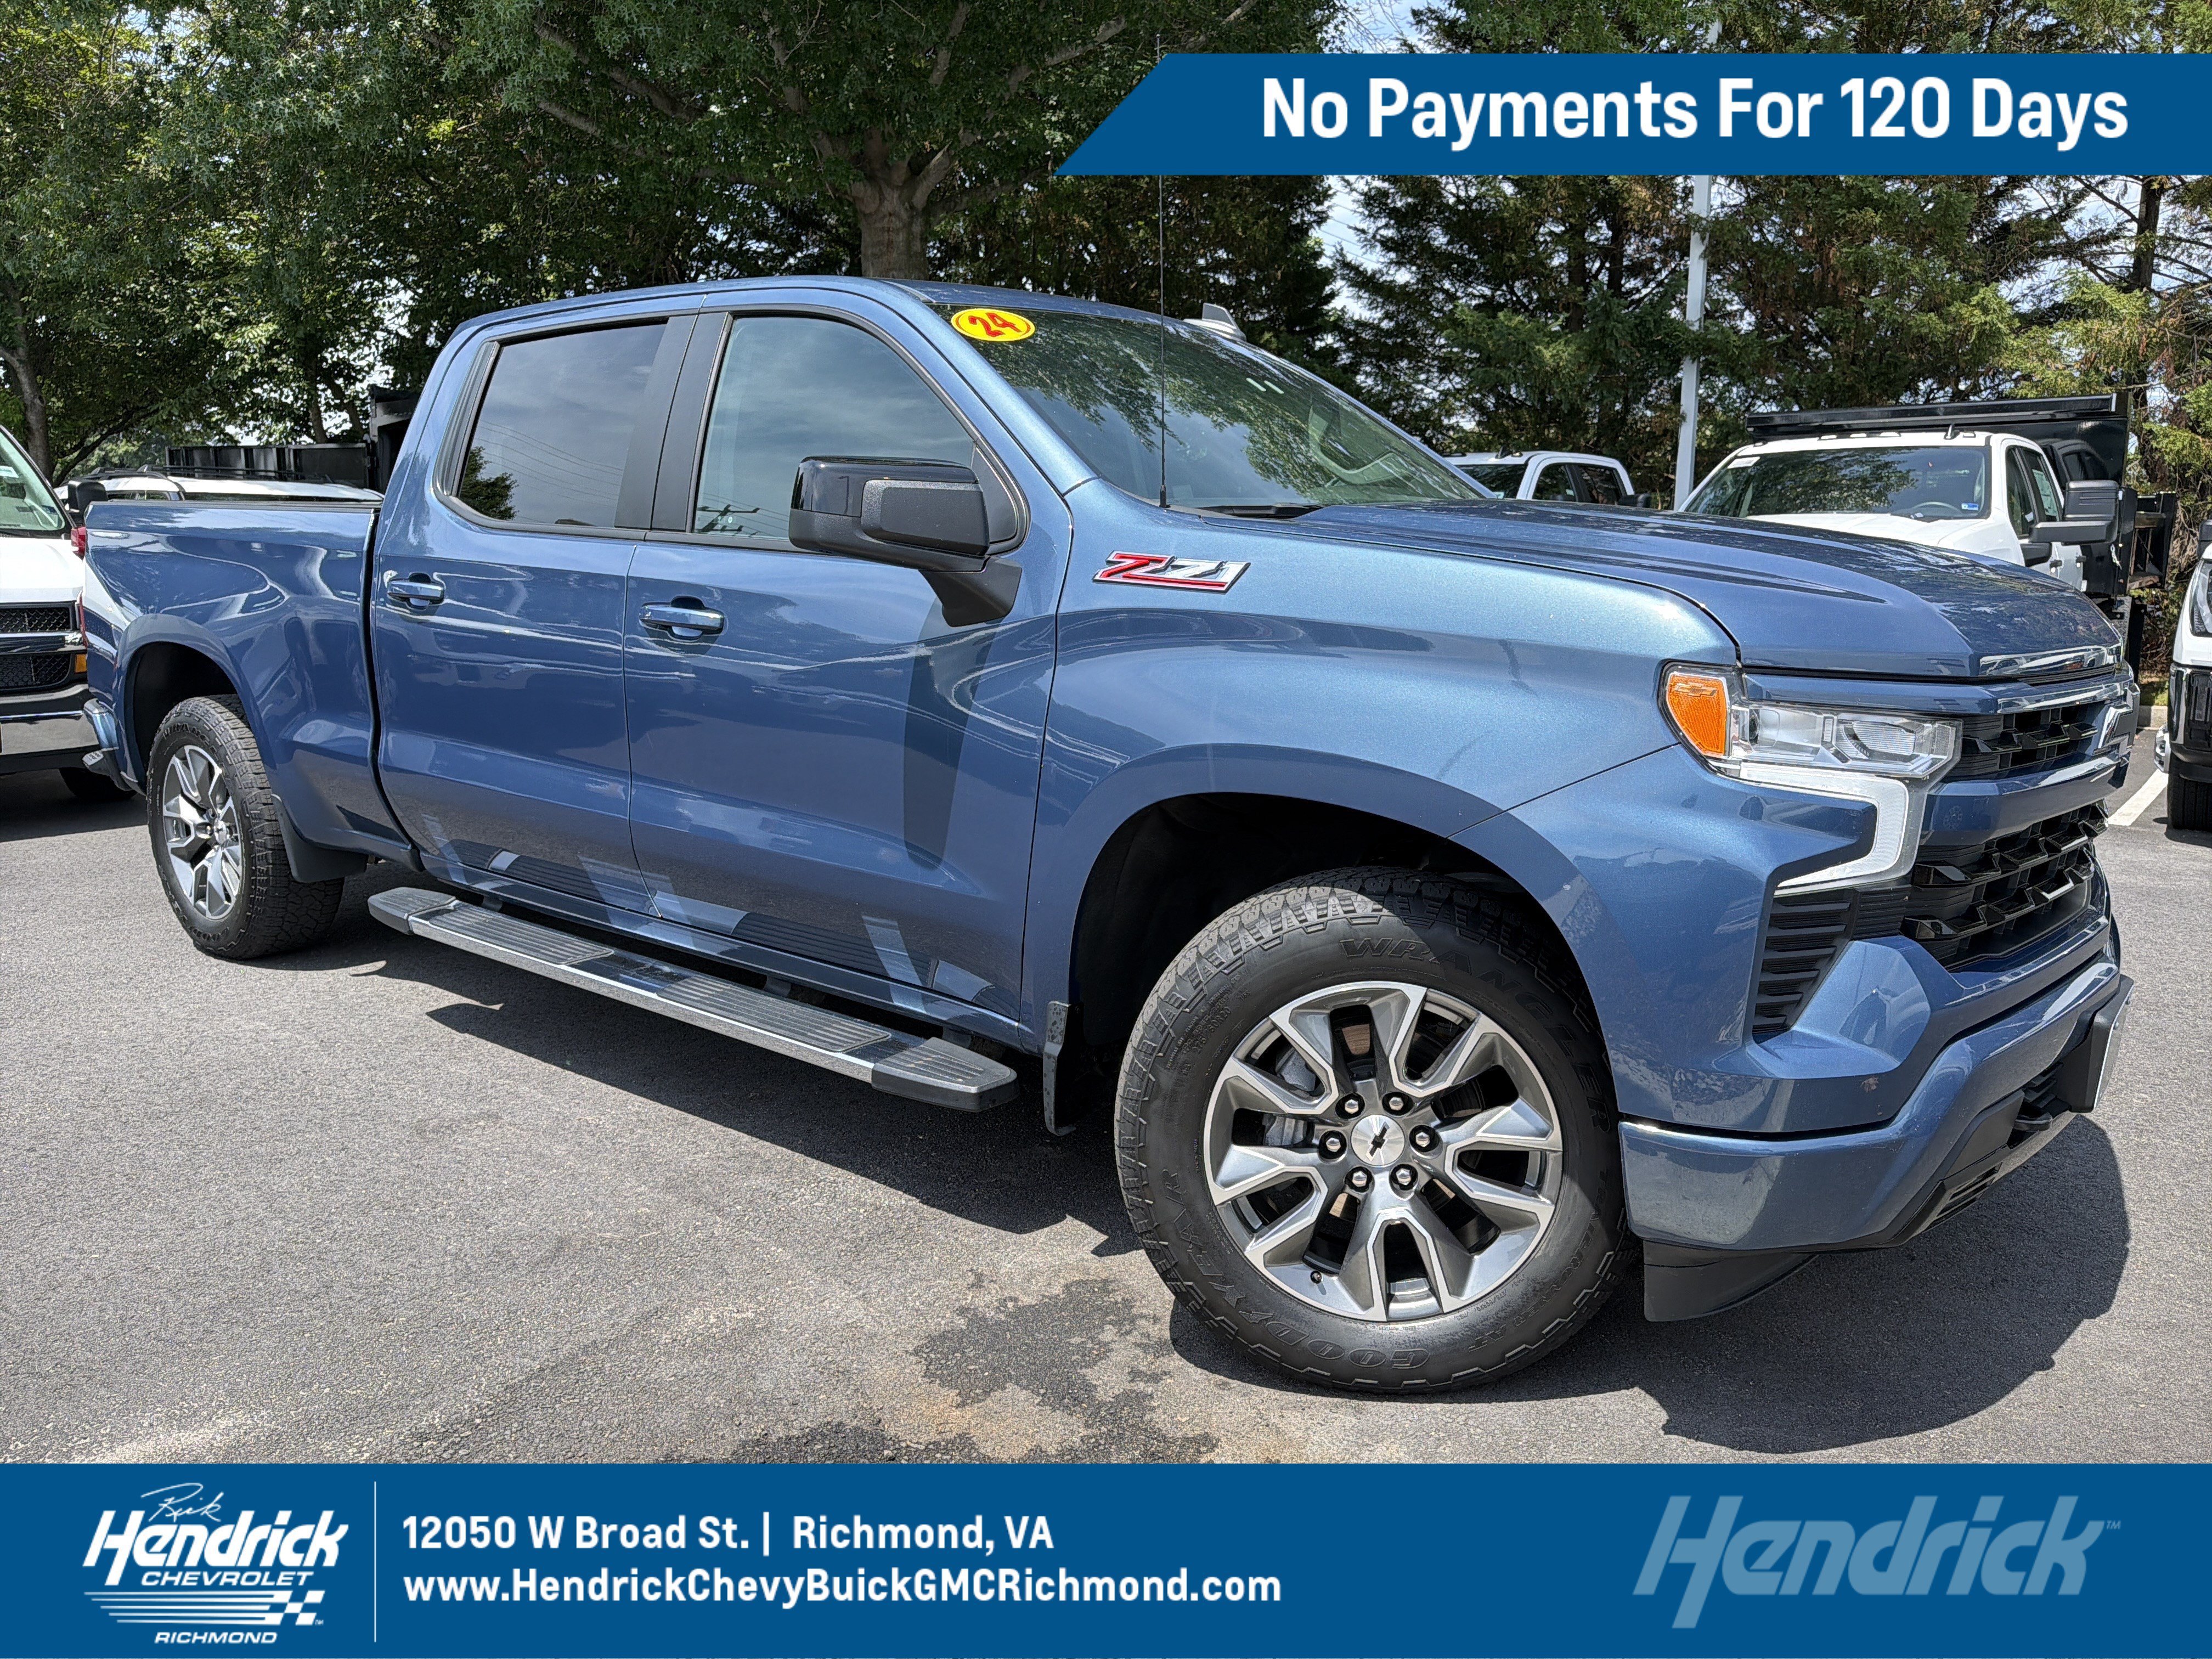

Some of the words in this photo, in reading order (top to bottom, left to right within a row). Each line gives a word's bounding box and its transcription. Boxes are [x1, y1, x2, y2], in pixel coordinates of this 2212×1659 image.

[968, 312, 1022, 337] 24
[1092, 550, 1251, 594] Z71
[1339, 937, 1611, 1133] WRANGLER
[1161, 1169, 1430, 1369] GOODYEAR
